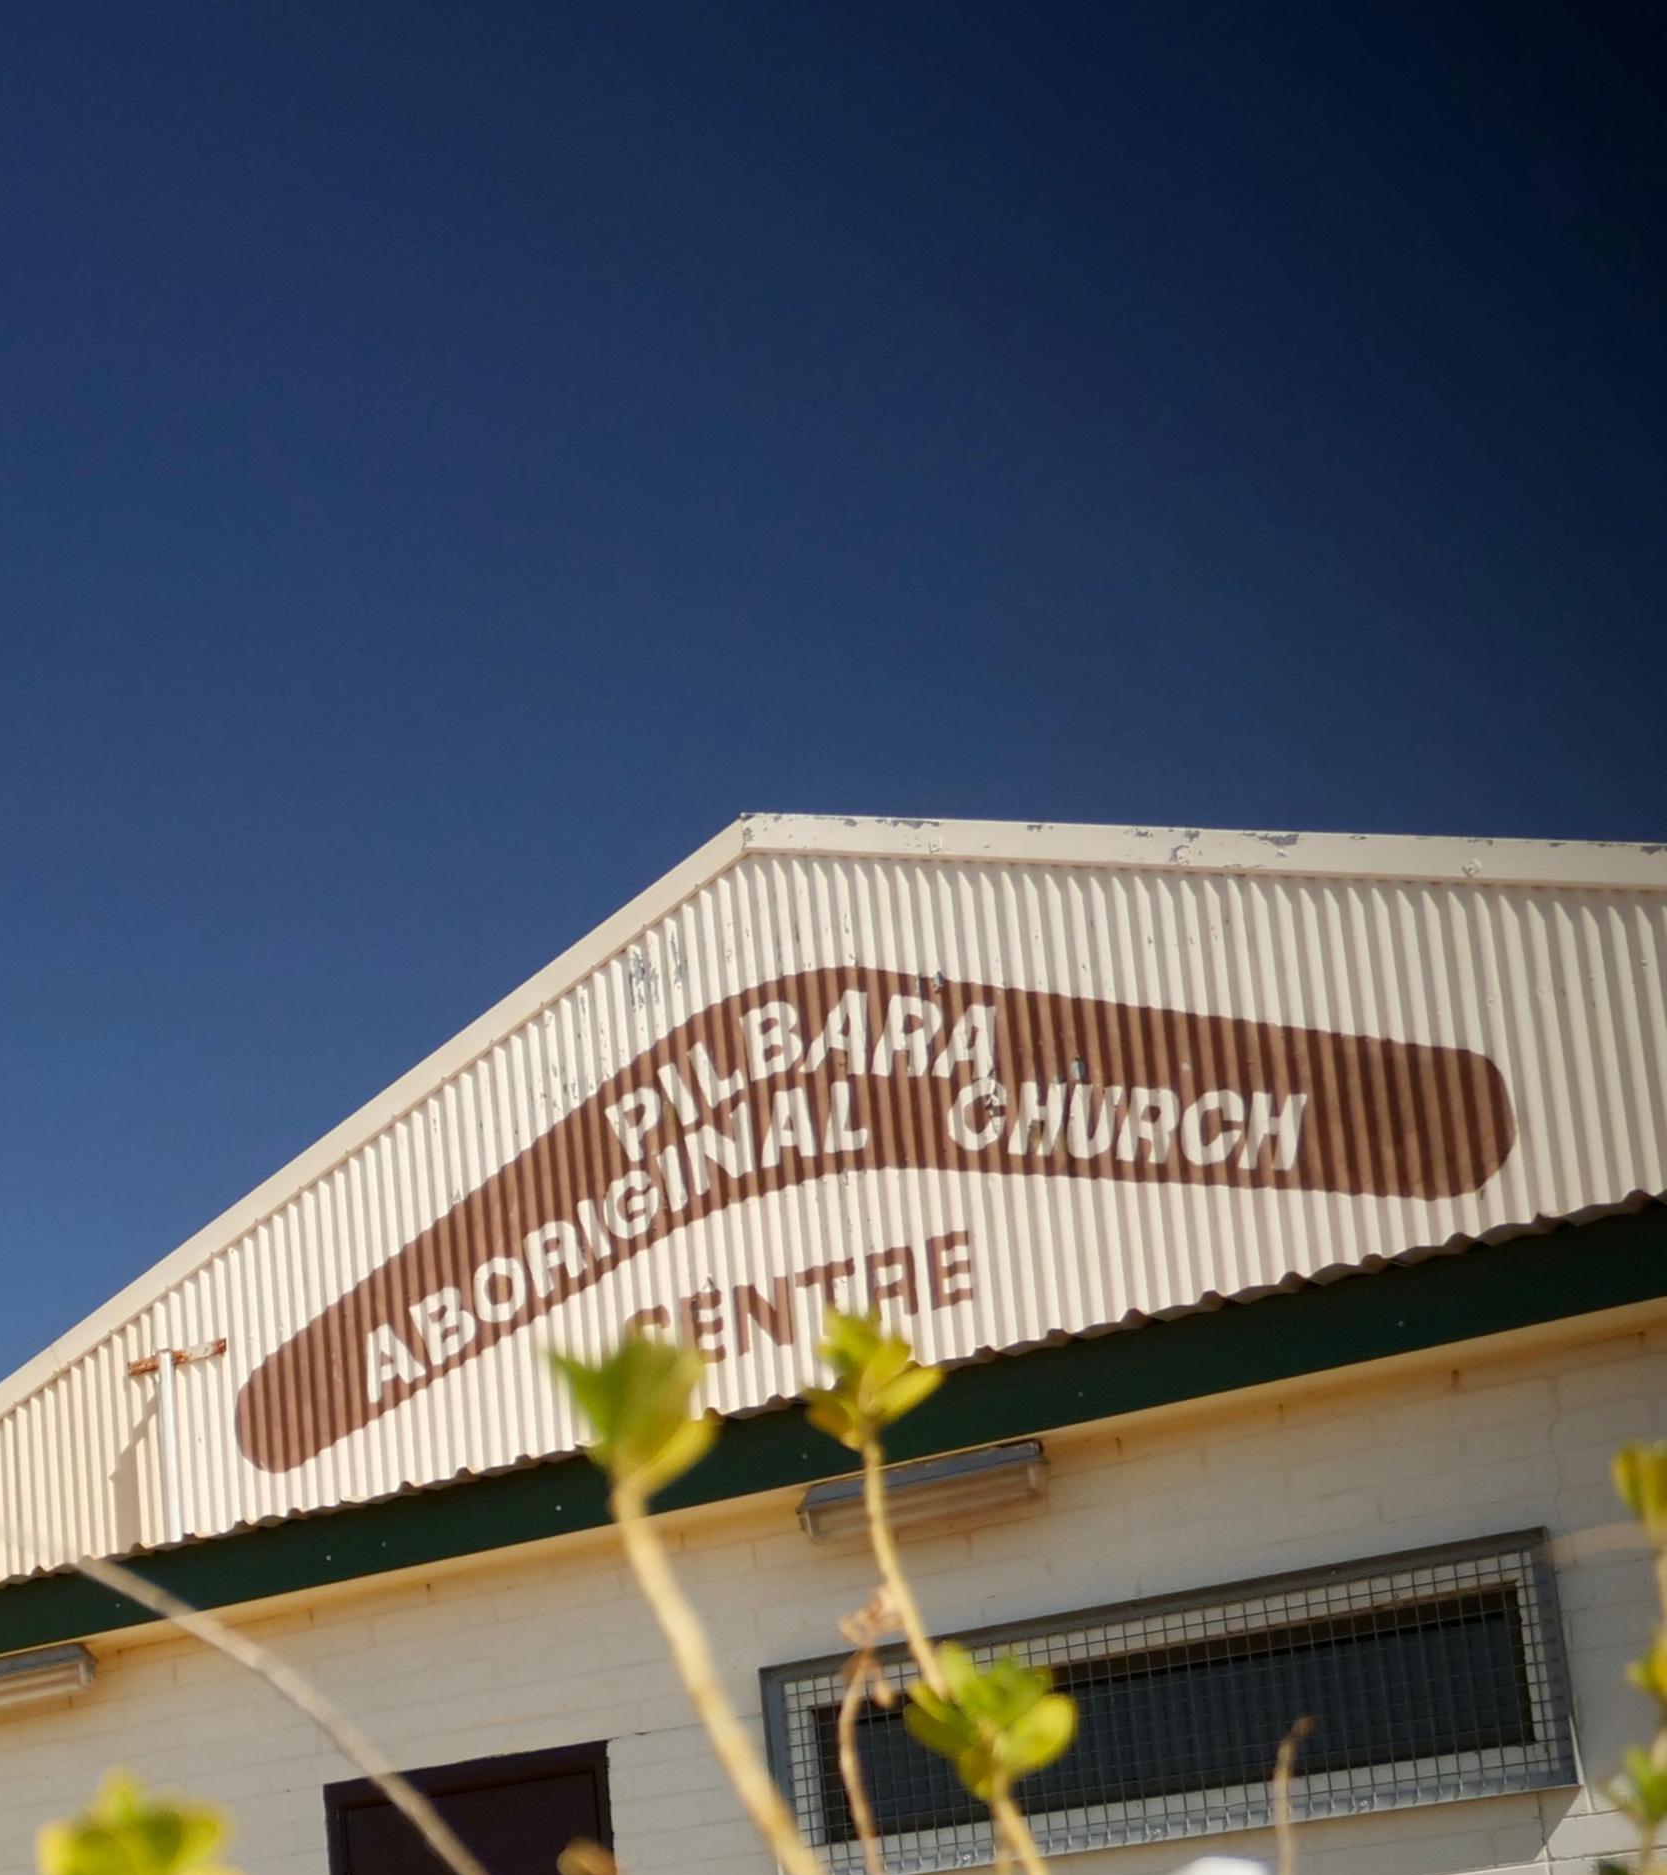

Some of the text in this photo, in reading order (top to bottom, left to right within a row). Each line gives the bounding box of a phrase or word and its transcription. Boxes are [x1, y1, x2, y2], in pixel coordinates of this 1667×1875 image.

[604, 989, 997, 1162] PILBARA
[366, 1077, 1308, 1403] ABORIGINAL CHURCH
